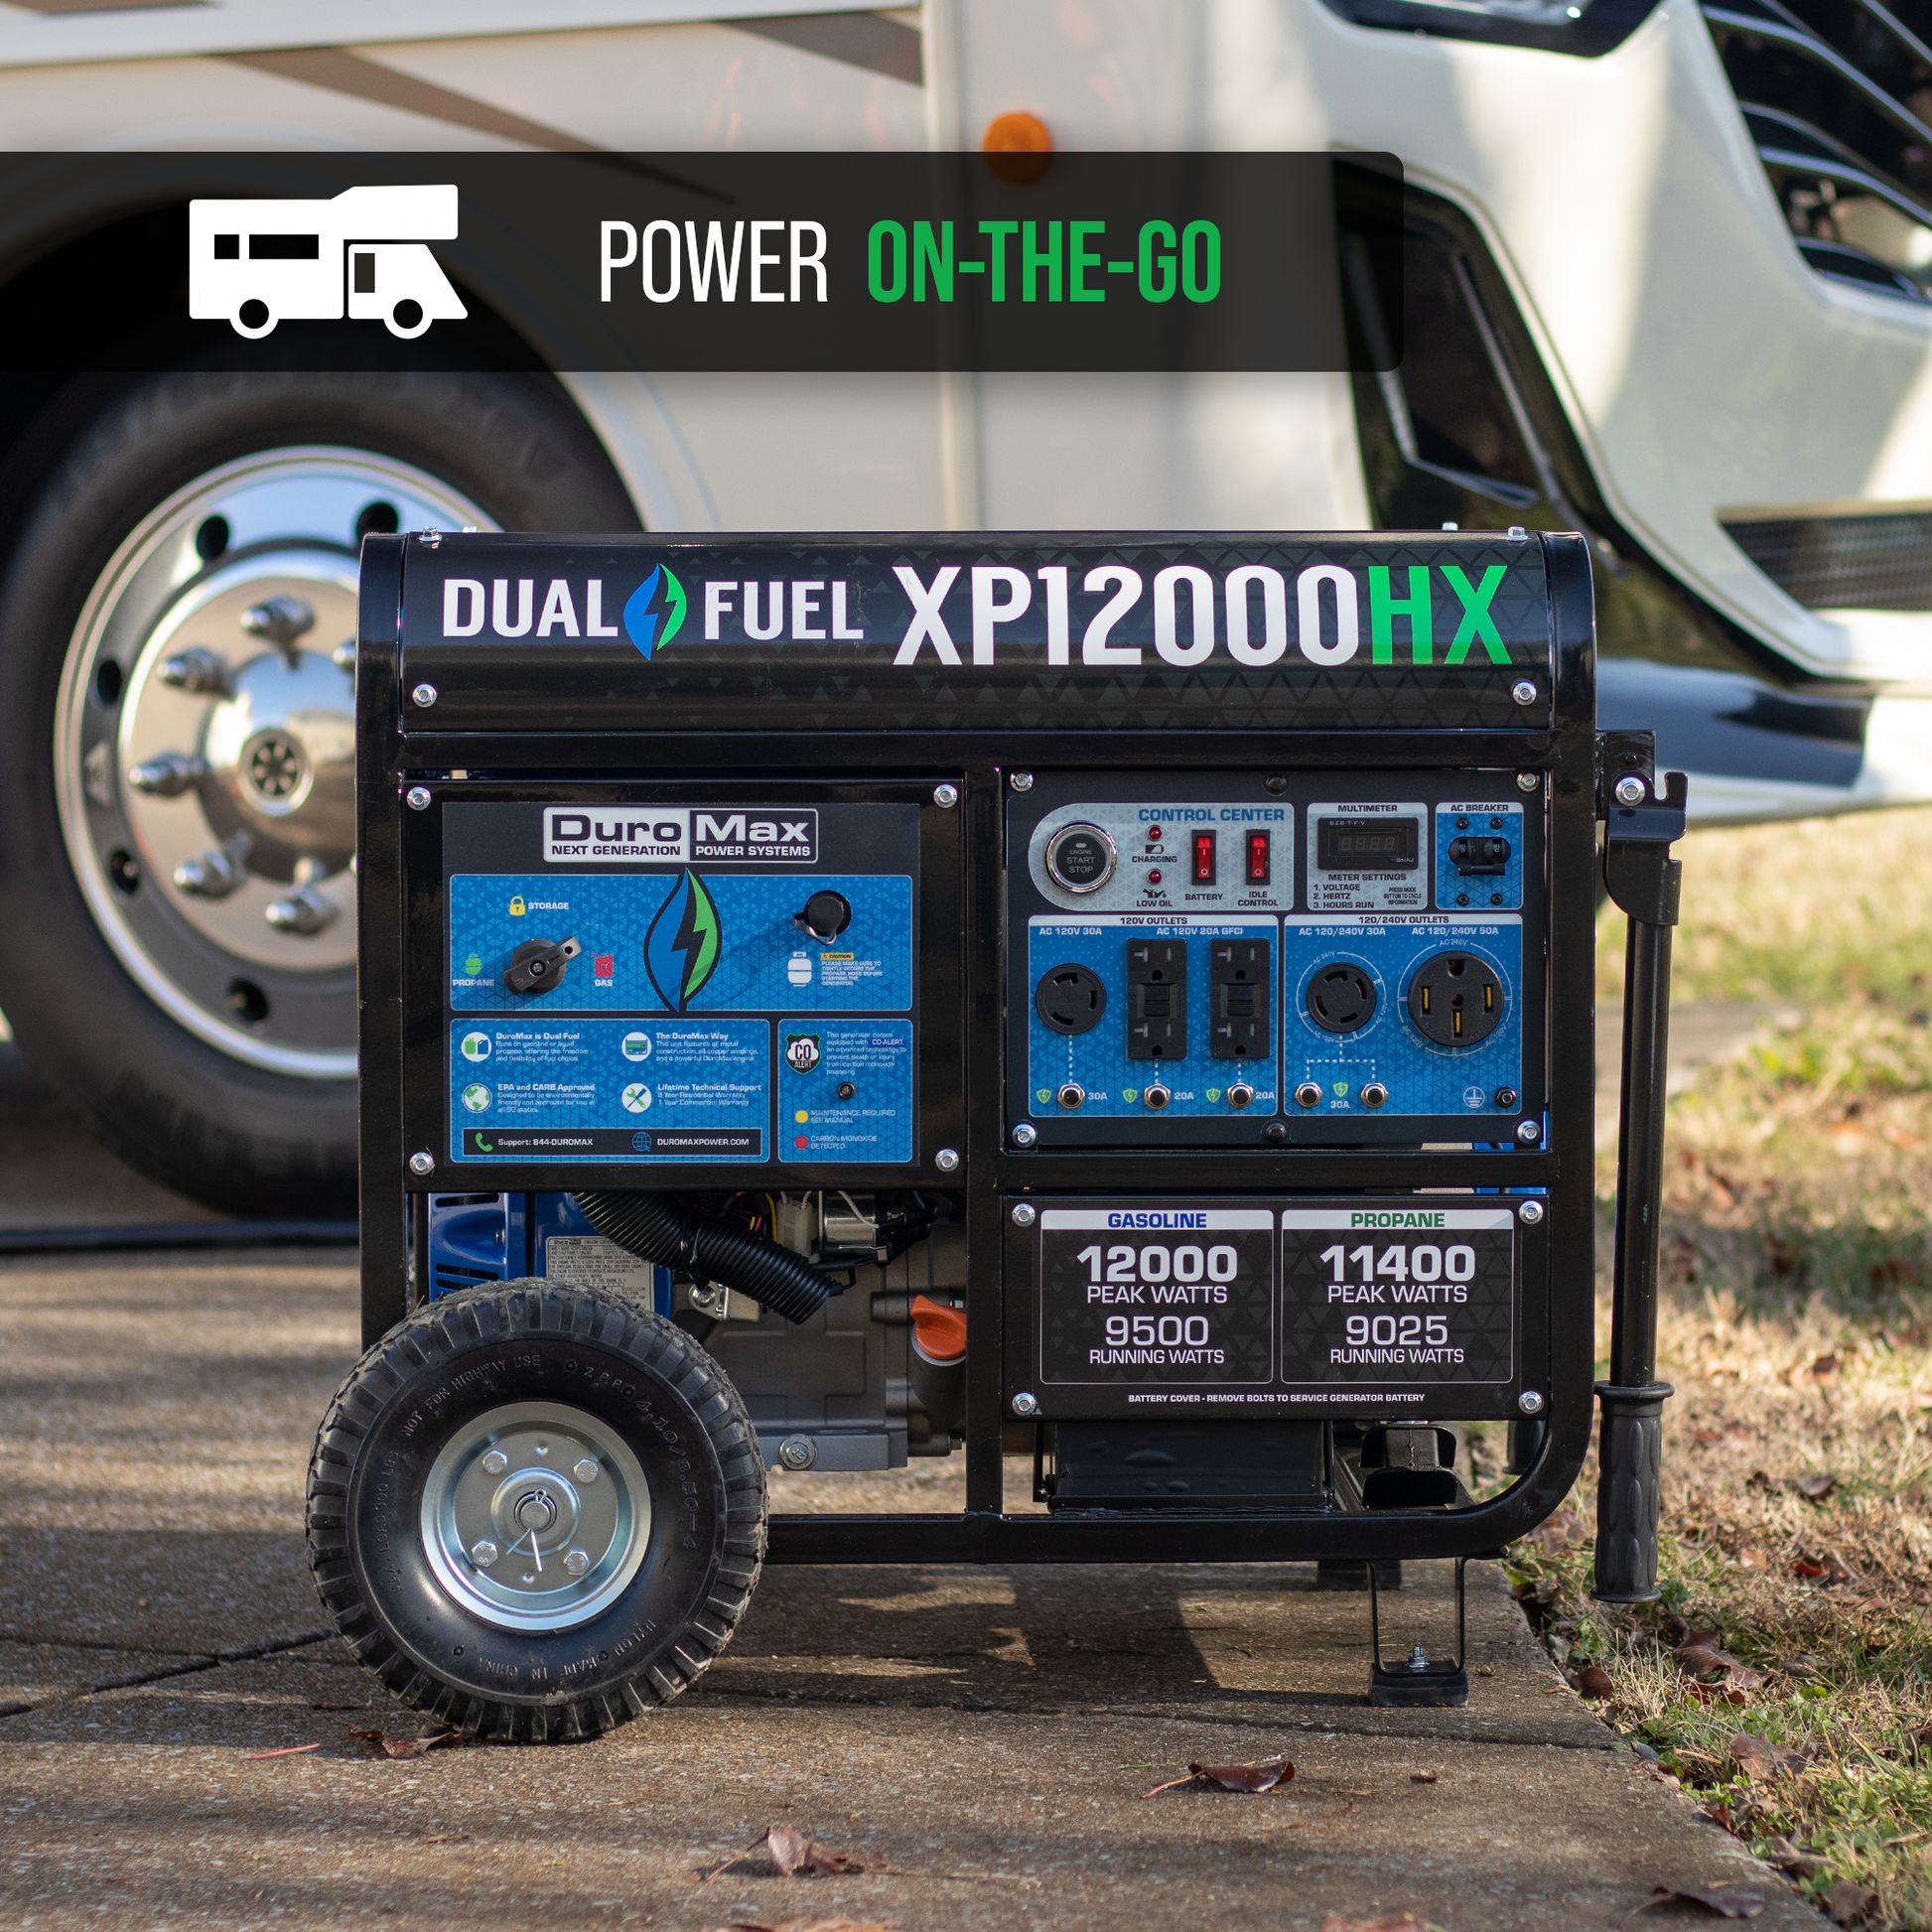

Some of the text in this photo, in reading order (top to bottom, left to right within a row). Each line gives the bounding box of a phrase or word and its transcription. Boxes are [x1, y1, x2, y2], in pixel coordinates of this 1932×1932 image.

[443, 564, 1513, 666] DUAL FUEL XP12000HX
[1138, 808, 1285, 822] CONTROL CENTER
[552, 845, 680, 856] NEXT GENERATION
[696, 846, 811, 857] POWER SYSTEMS
[1131, 856, 1177, 864] CHARGING
[528, 902, 569, 910] STORAGE
[1120, 917, 1188, 925] 120V OUTLETS
[1359, 916, 1449, 924] 120/240V OUTLETS
[1299, 927, 1386, 936] AC 120/240V 30A
[1411, 927, 1499, 935] AC 120/240V 50A
[1312, 951, 1336, 965] AC 240V
[452, 978, 495, 987] PROPANE
[710, 1033, 728, 1041] Way
[795, 1044, 812, 1060] CO
[557, 1084, 595, 1092] Approved
[729, 1084, 762, 1092] Support
[1088, 1092, 1108, 1101] 30A
[1174, 1092, 1194, 1101] 20A
[1255, 1092, 1275, 1101] 20A
[1330, 1100, 1350, 1109] 30A
[498, 1138, 532, 1147] Support:
[1107, 1212, 1207, 1229] GASOLINE
[1350, 1212, 1445, 1229] PROPANE
[1076, 1244, 1238, 1283] 12000
[1319, 1244, 1476, 1283] 11400
[1087, 1286, 1228, 1304] PEAK WATTS
[1327, 1286, 1467, 1304] PEAK WATTS
[1105, 1315, 1209, 1346] 9500
[1345, 1315, 1449, 1346] 9025
[1089, 1349, 1225, 1365] RUNNING WATTS
[1330, 1349, 1464, 1364] RUNNING WATTS
[401, 1354, 541, 1437] NOT FOR HIGHWAY USE
[1128, 1394, 1425, 1403] BATTERY COVER REMOVE BOLTS TO SERVICE GENERATOR BATTERY
[614, 1619, 656, 1657] NYLON
[479, 1656, 597, 1680] MADE IN CHINA
